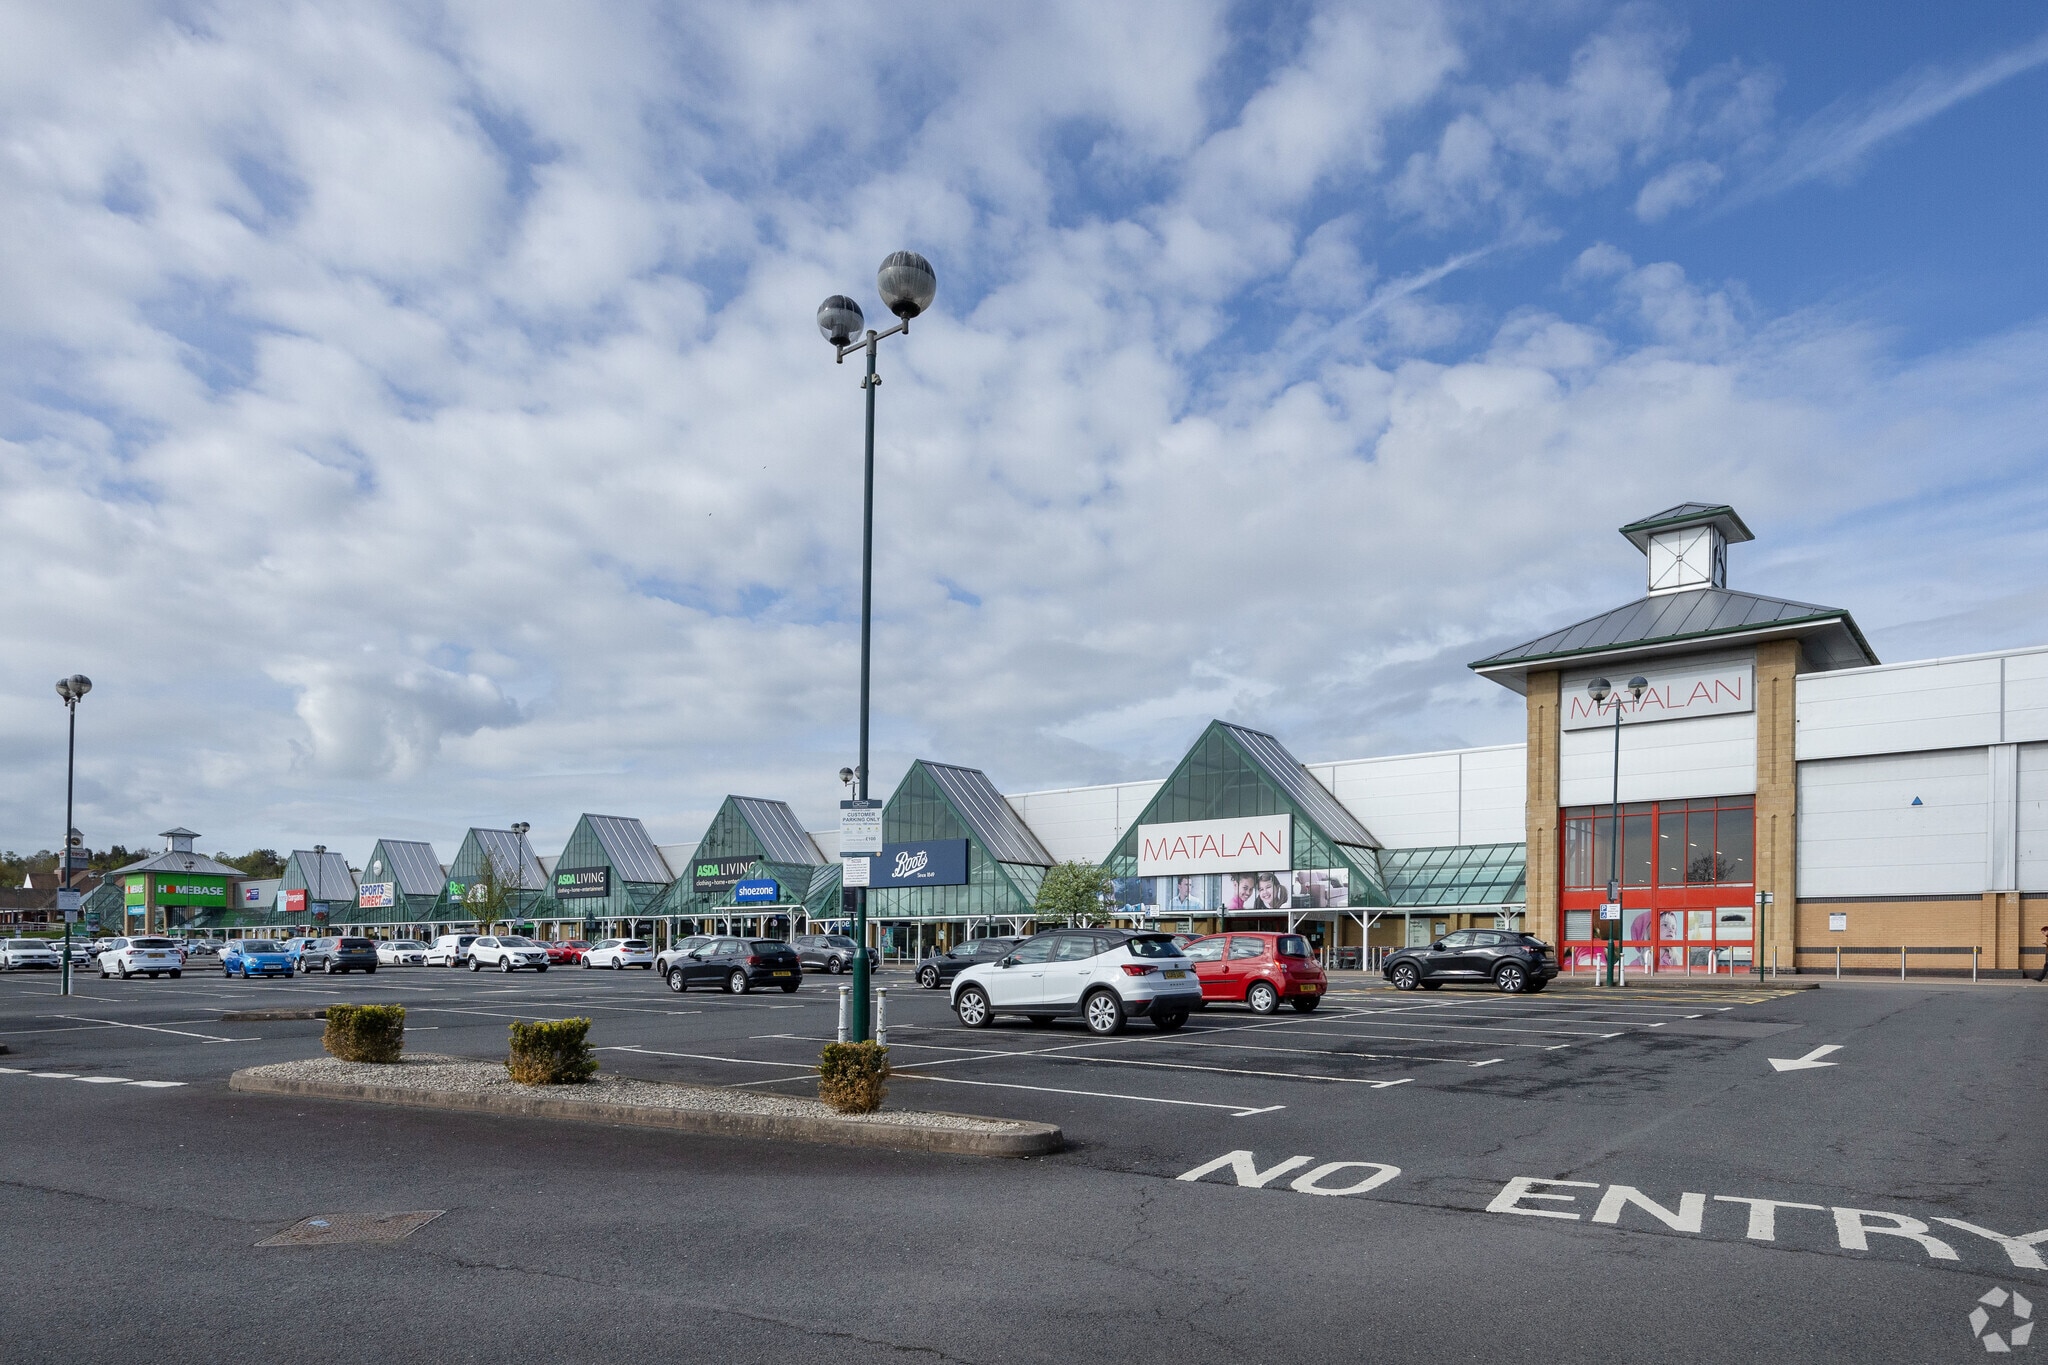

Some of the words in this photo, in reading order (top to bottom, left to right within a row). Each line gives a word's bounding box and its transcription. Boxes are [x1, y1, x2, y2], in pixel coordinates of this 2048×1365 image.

[1570, 676, 1742, 720] MATALAN
[1143, 829, 1282, 862] MATALAN
[696, 864, 720, 877] ASDA
[891, 850, 928, 878] Boots
[557, 873, 576, 885] ASDA
[576, 871, 604, 884] LIVING
[695, 879, 712, 887] clothing
[157, 884, 224, 896] HOMEBASE
[360, 884, 385, 896] SPORTS
[738, 886, 774, 896] shoezone
[1174, 1149, 1402, 1197] NO
[1485, 1176, 2048, 1271] ENTRY
